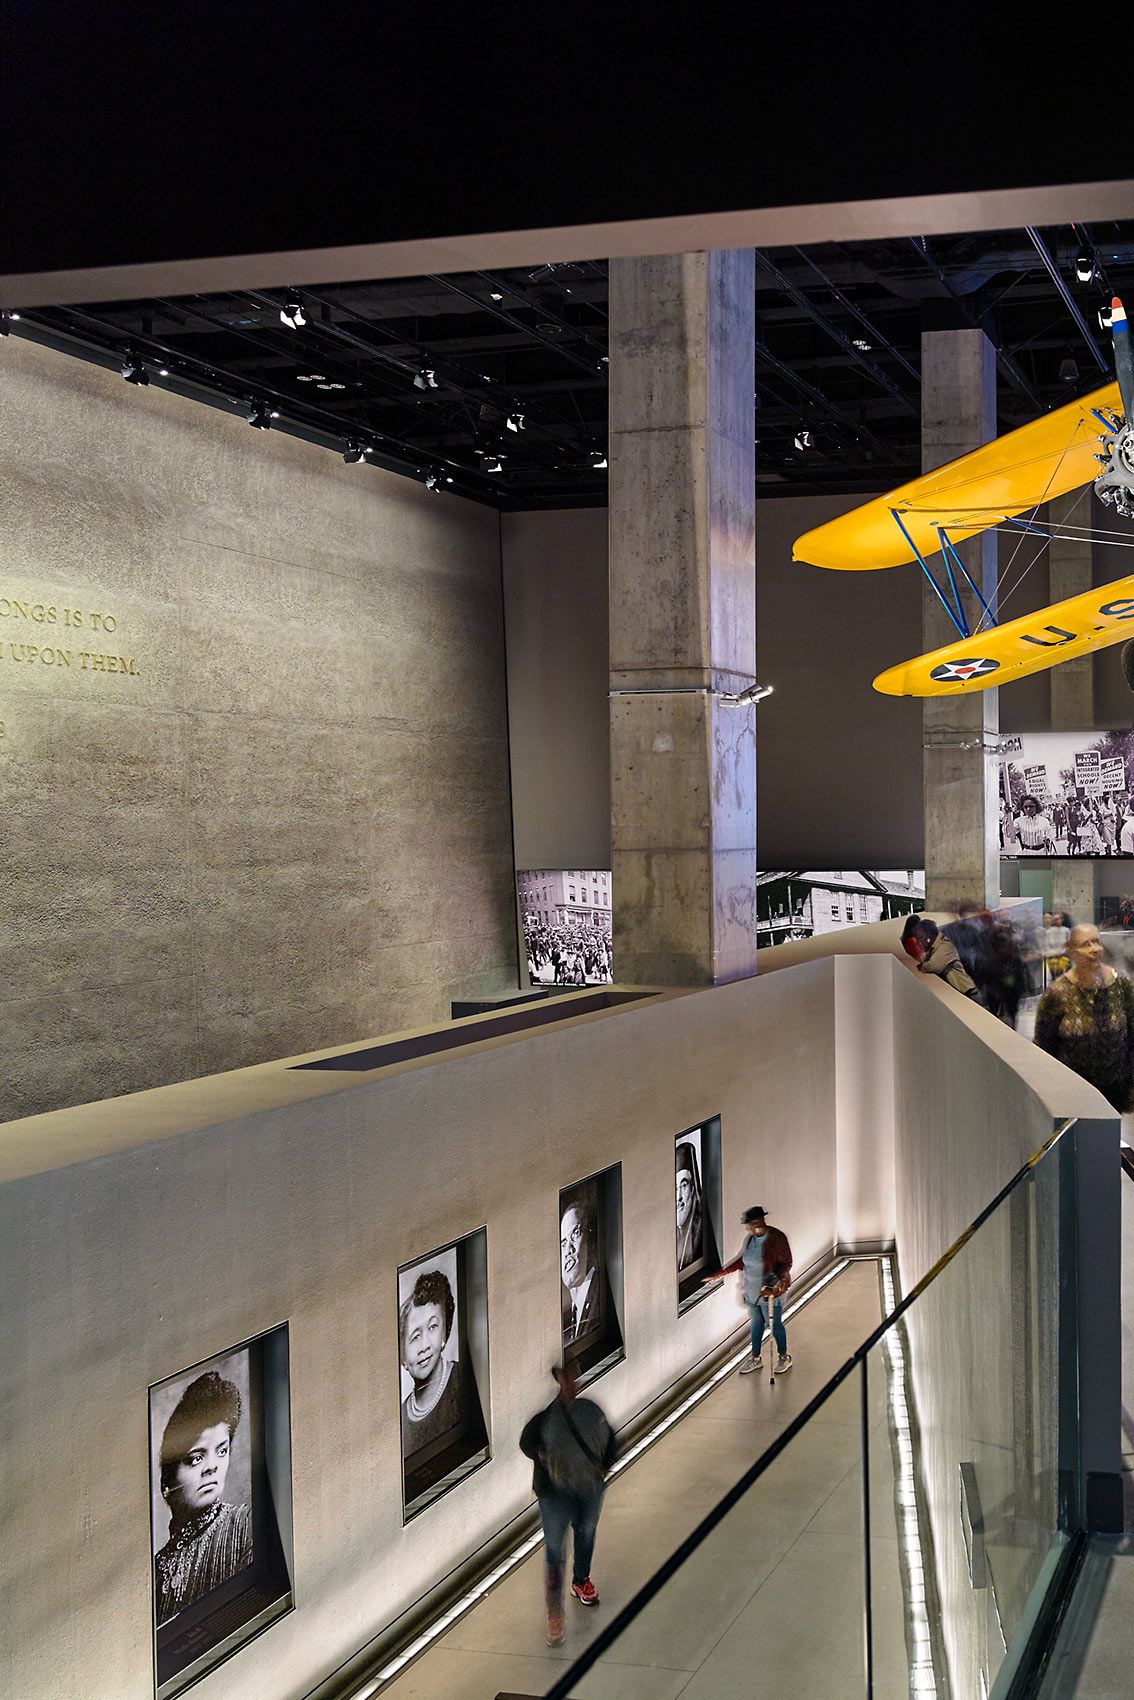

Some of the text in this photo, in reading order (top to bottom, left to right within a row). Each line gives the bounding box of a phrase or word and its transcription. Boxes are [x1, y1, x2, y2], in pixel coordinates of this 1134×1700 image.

[64, 608, 82, 628] IS
[90, 613, 117, 632] TO
[10, 643, 71, 667] UPON
[78, 652, 140, 676] THEM.
